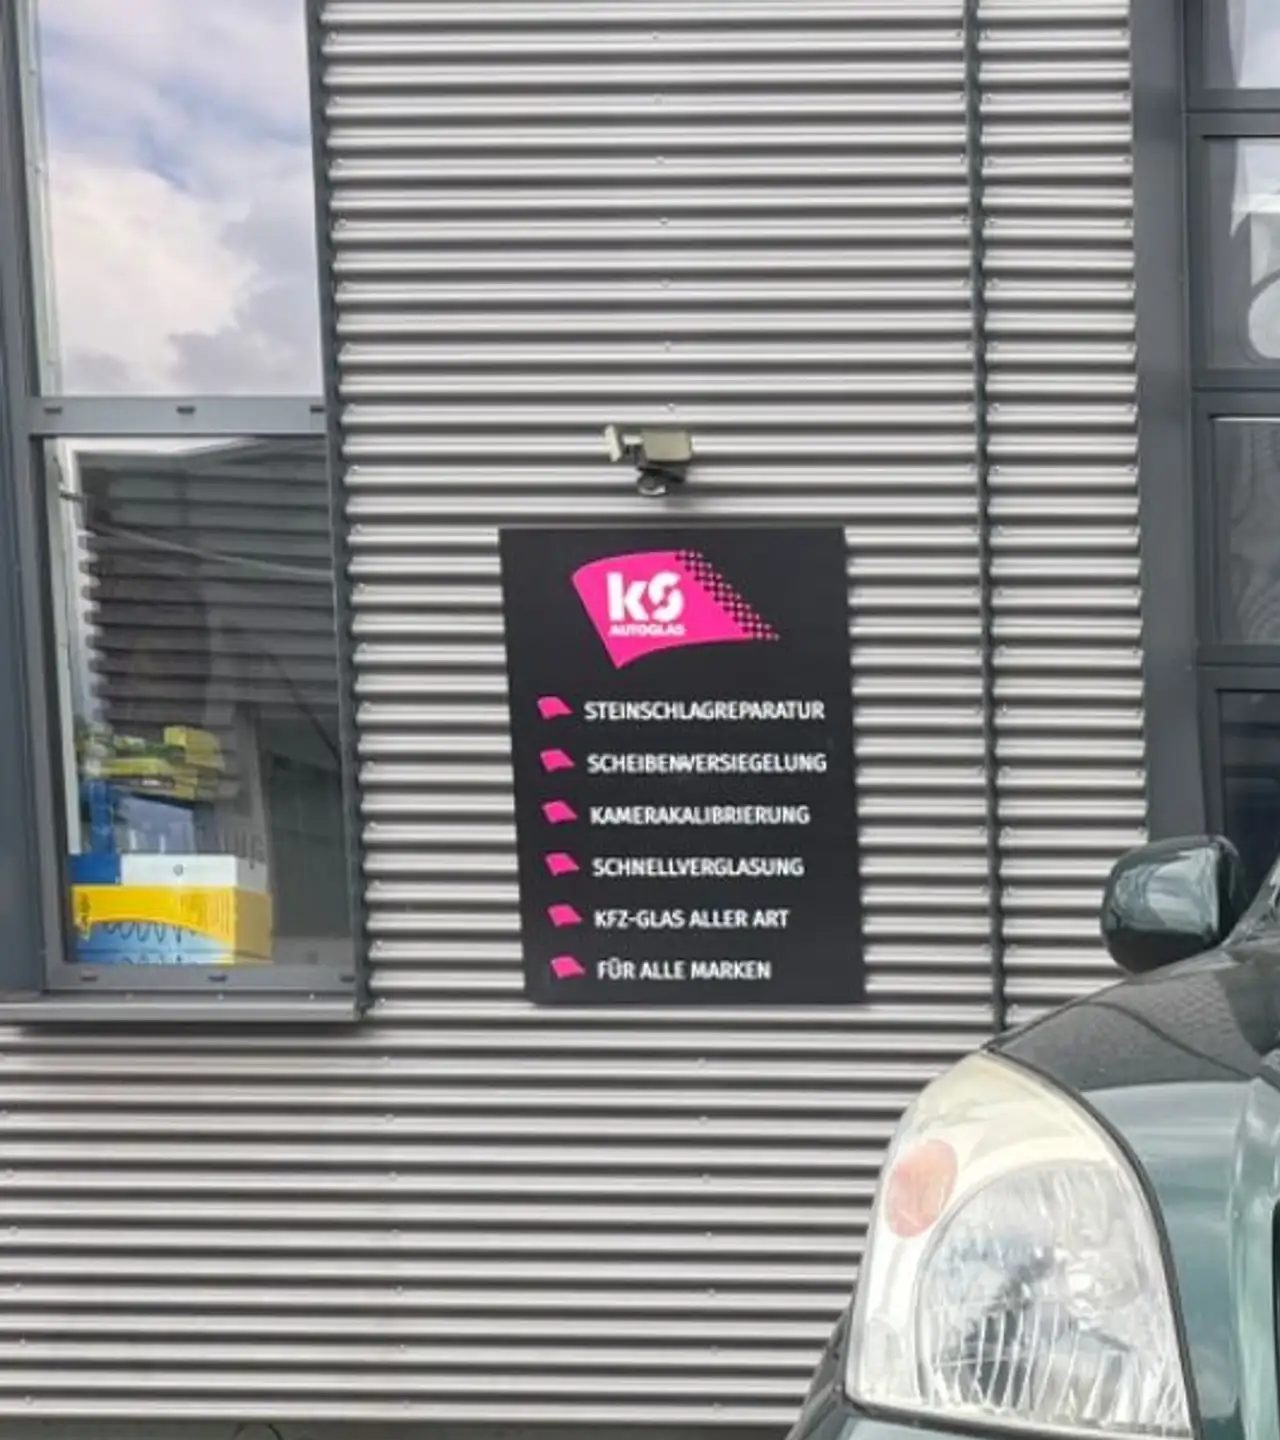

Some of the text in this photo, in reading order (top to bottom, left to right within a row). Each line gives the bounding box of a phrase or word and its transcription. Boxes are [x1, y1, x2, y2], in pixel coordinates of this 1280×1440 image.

[609, 623, 686, 637] AUTOGLAS
[584, 701, 826, 721] STEINSCHLAGREPARATUR
[586, 753, 828, 774] SCHEIBENVERSIEGELUNG
[590, 806, 811, 825] KAMERAKALIBRIERUNG
[591, 857, 805, 878] SCHNELLVERGLASUNG
[594, 909, 790, 929] KFZ-GLAS ALLER ART
[596, 956, 772, 980] FÜR ALLE MARKEN
